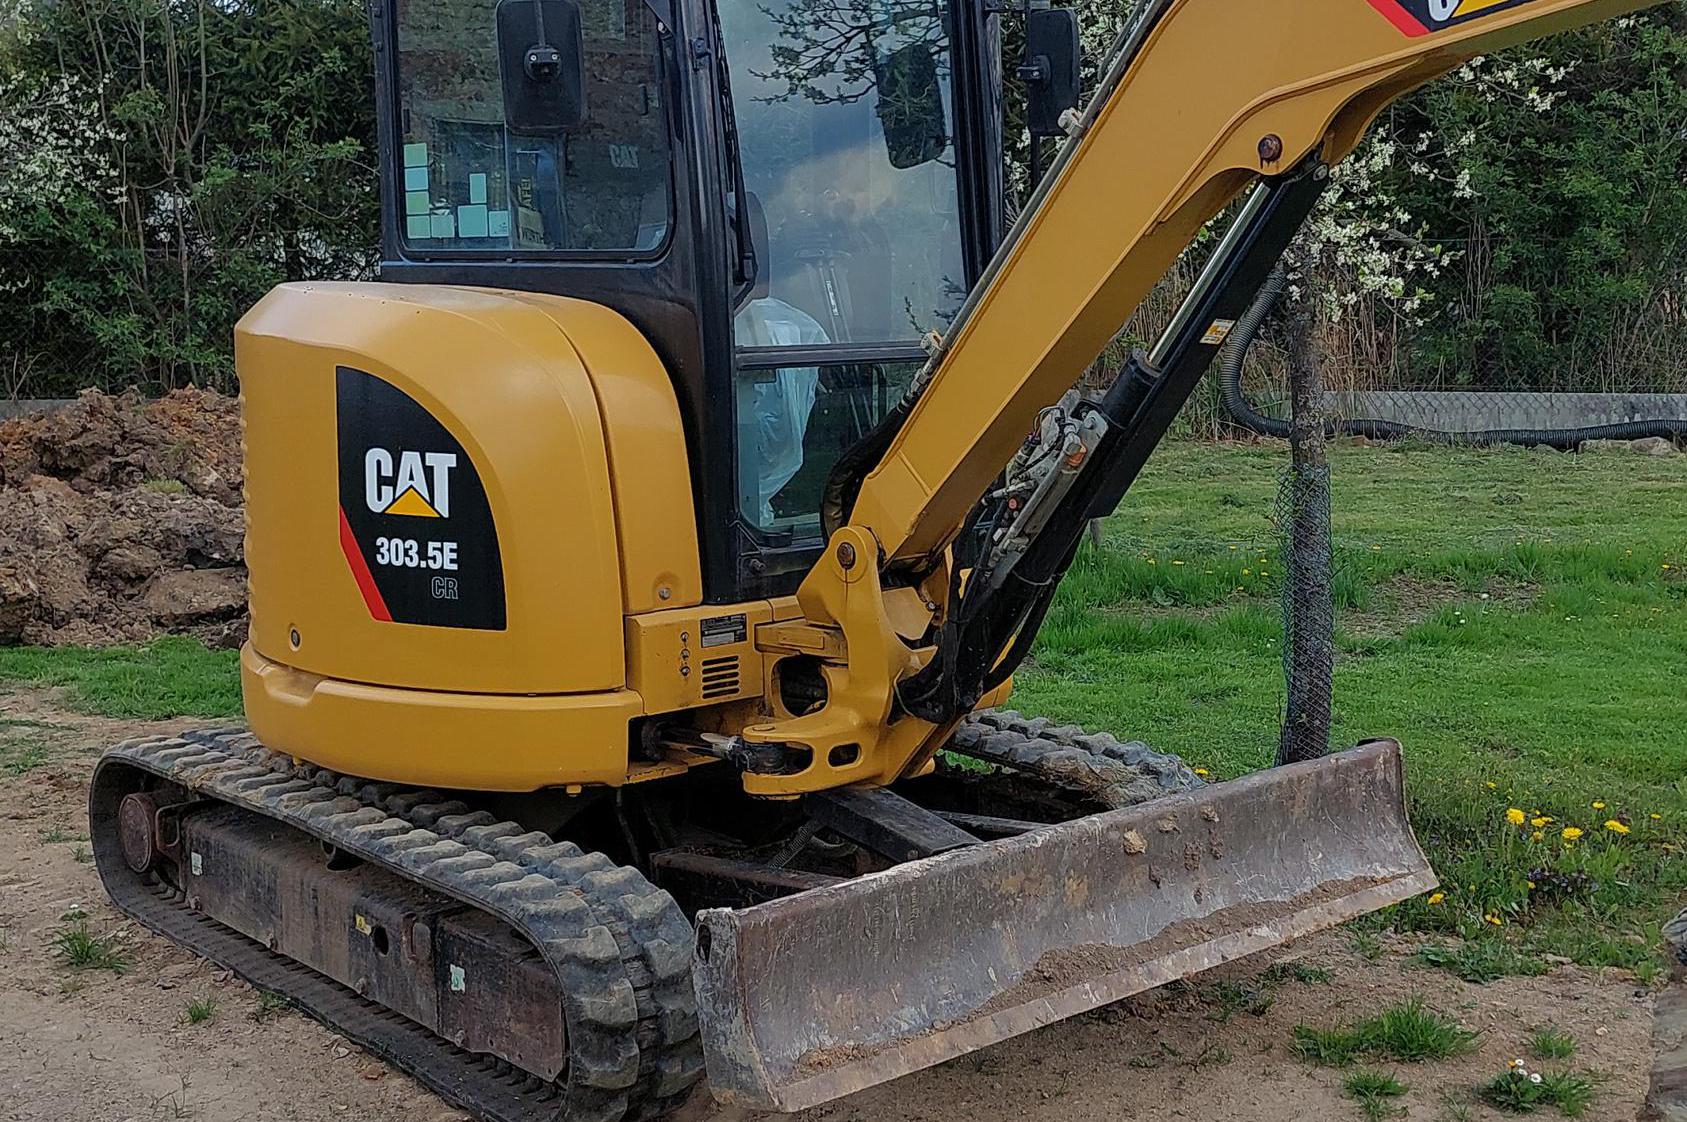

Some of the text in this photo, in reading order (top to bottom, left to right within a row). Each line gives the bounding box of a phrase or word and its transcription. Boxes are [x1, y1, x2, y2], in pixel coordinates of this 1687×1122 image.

[365, 447, 457, 518] CAT
[375, 537, 458, 570] 303.5E
[432, 576, 458, 599] CR
